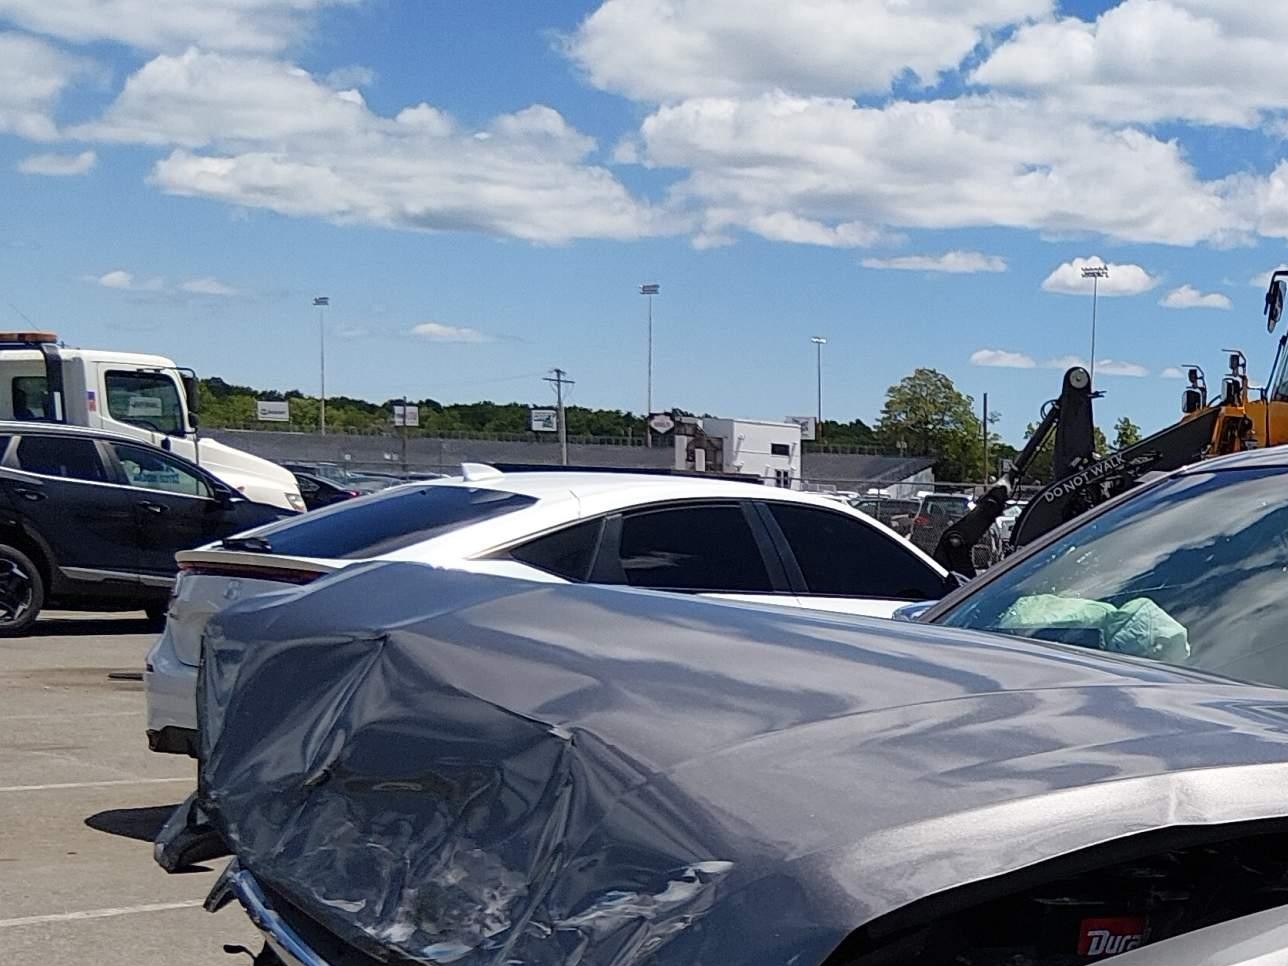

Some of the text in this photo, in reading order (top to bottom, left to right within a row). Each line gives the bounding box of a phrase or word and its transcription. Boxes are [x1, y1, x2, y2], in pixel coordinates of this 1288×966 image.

[1045, 452, 1125, 503] DO NOT WALK
